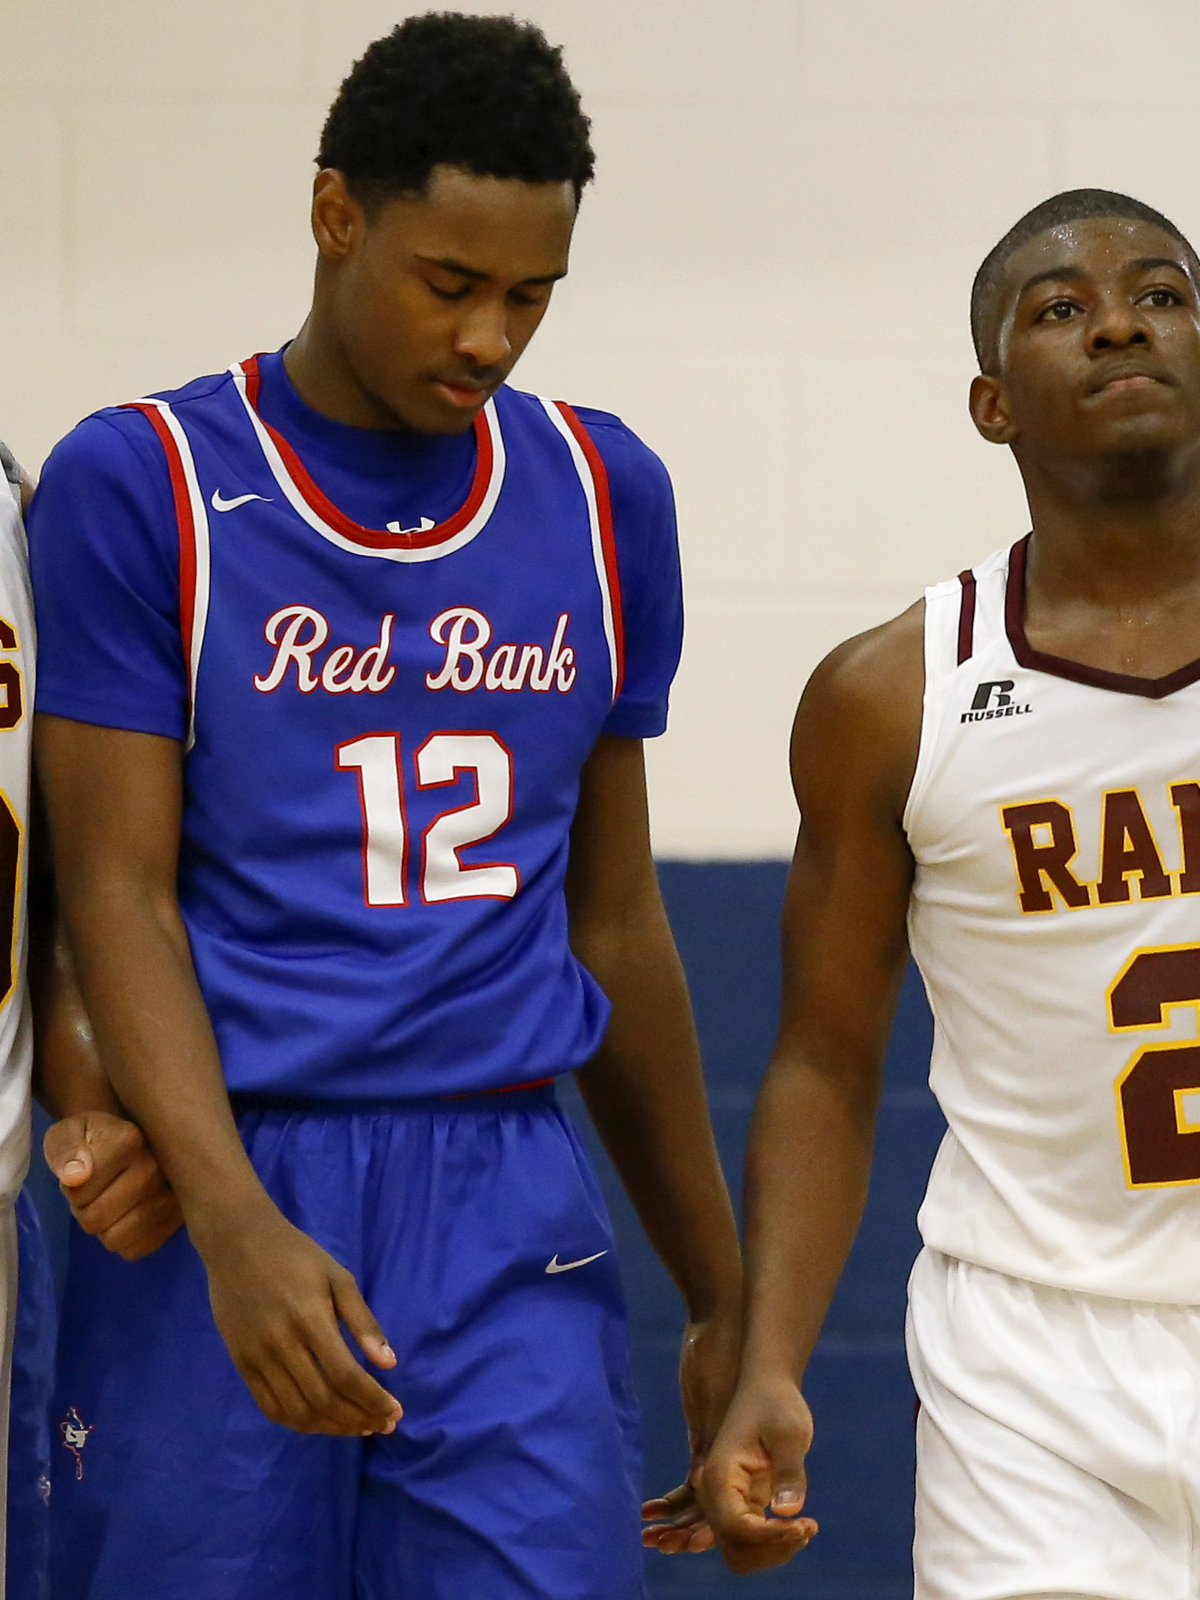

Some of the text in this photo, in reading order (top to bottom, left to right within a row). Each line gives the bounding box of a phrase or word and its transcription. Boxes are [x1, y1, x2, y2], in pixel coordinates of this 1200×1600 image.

[253, 604, 577, 693] Red Bank
[960, 703, 1033, 724] RUSSELL
[334, 730, 518, 908] 12
